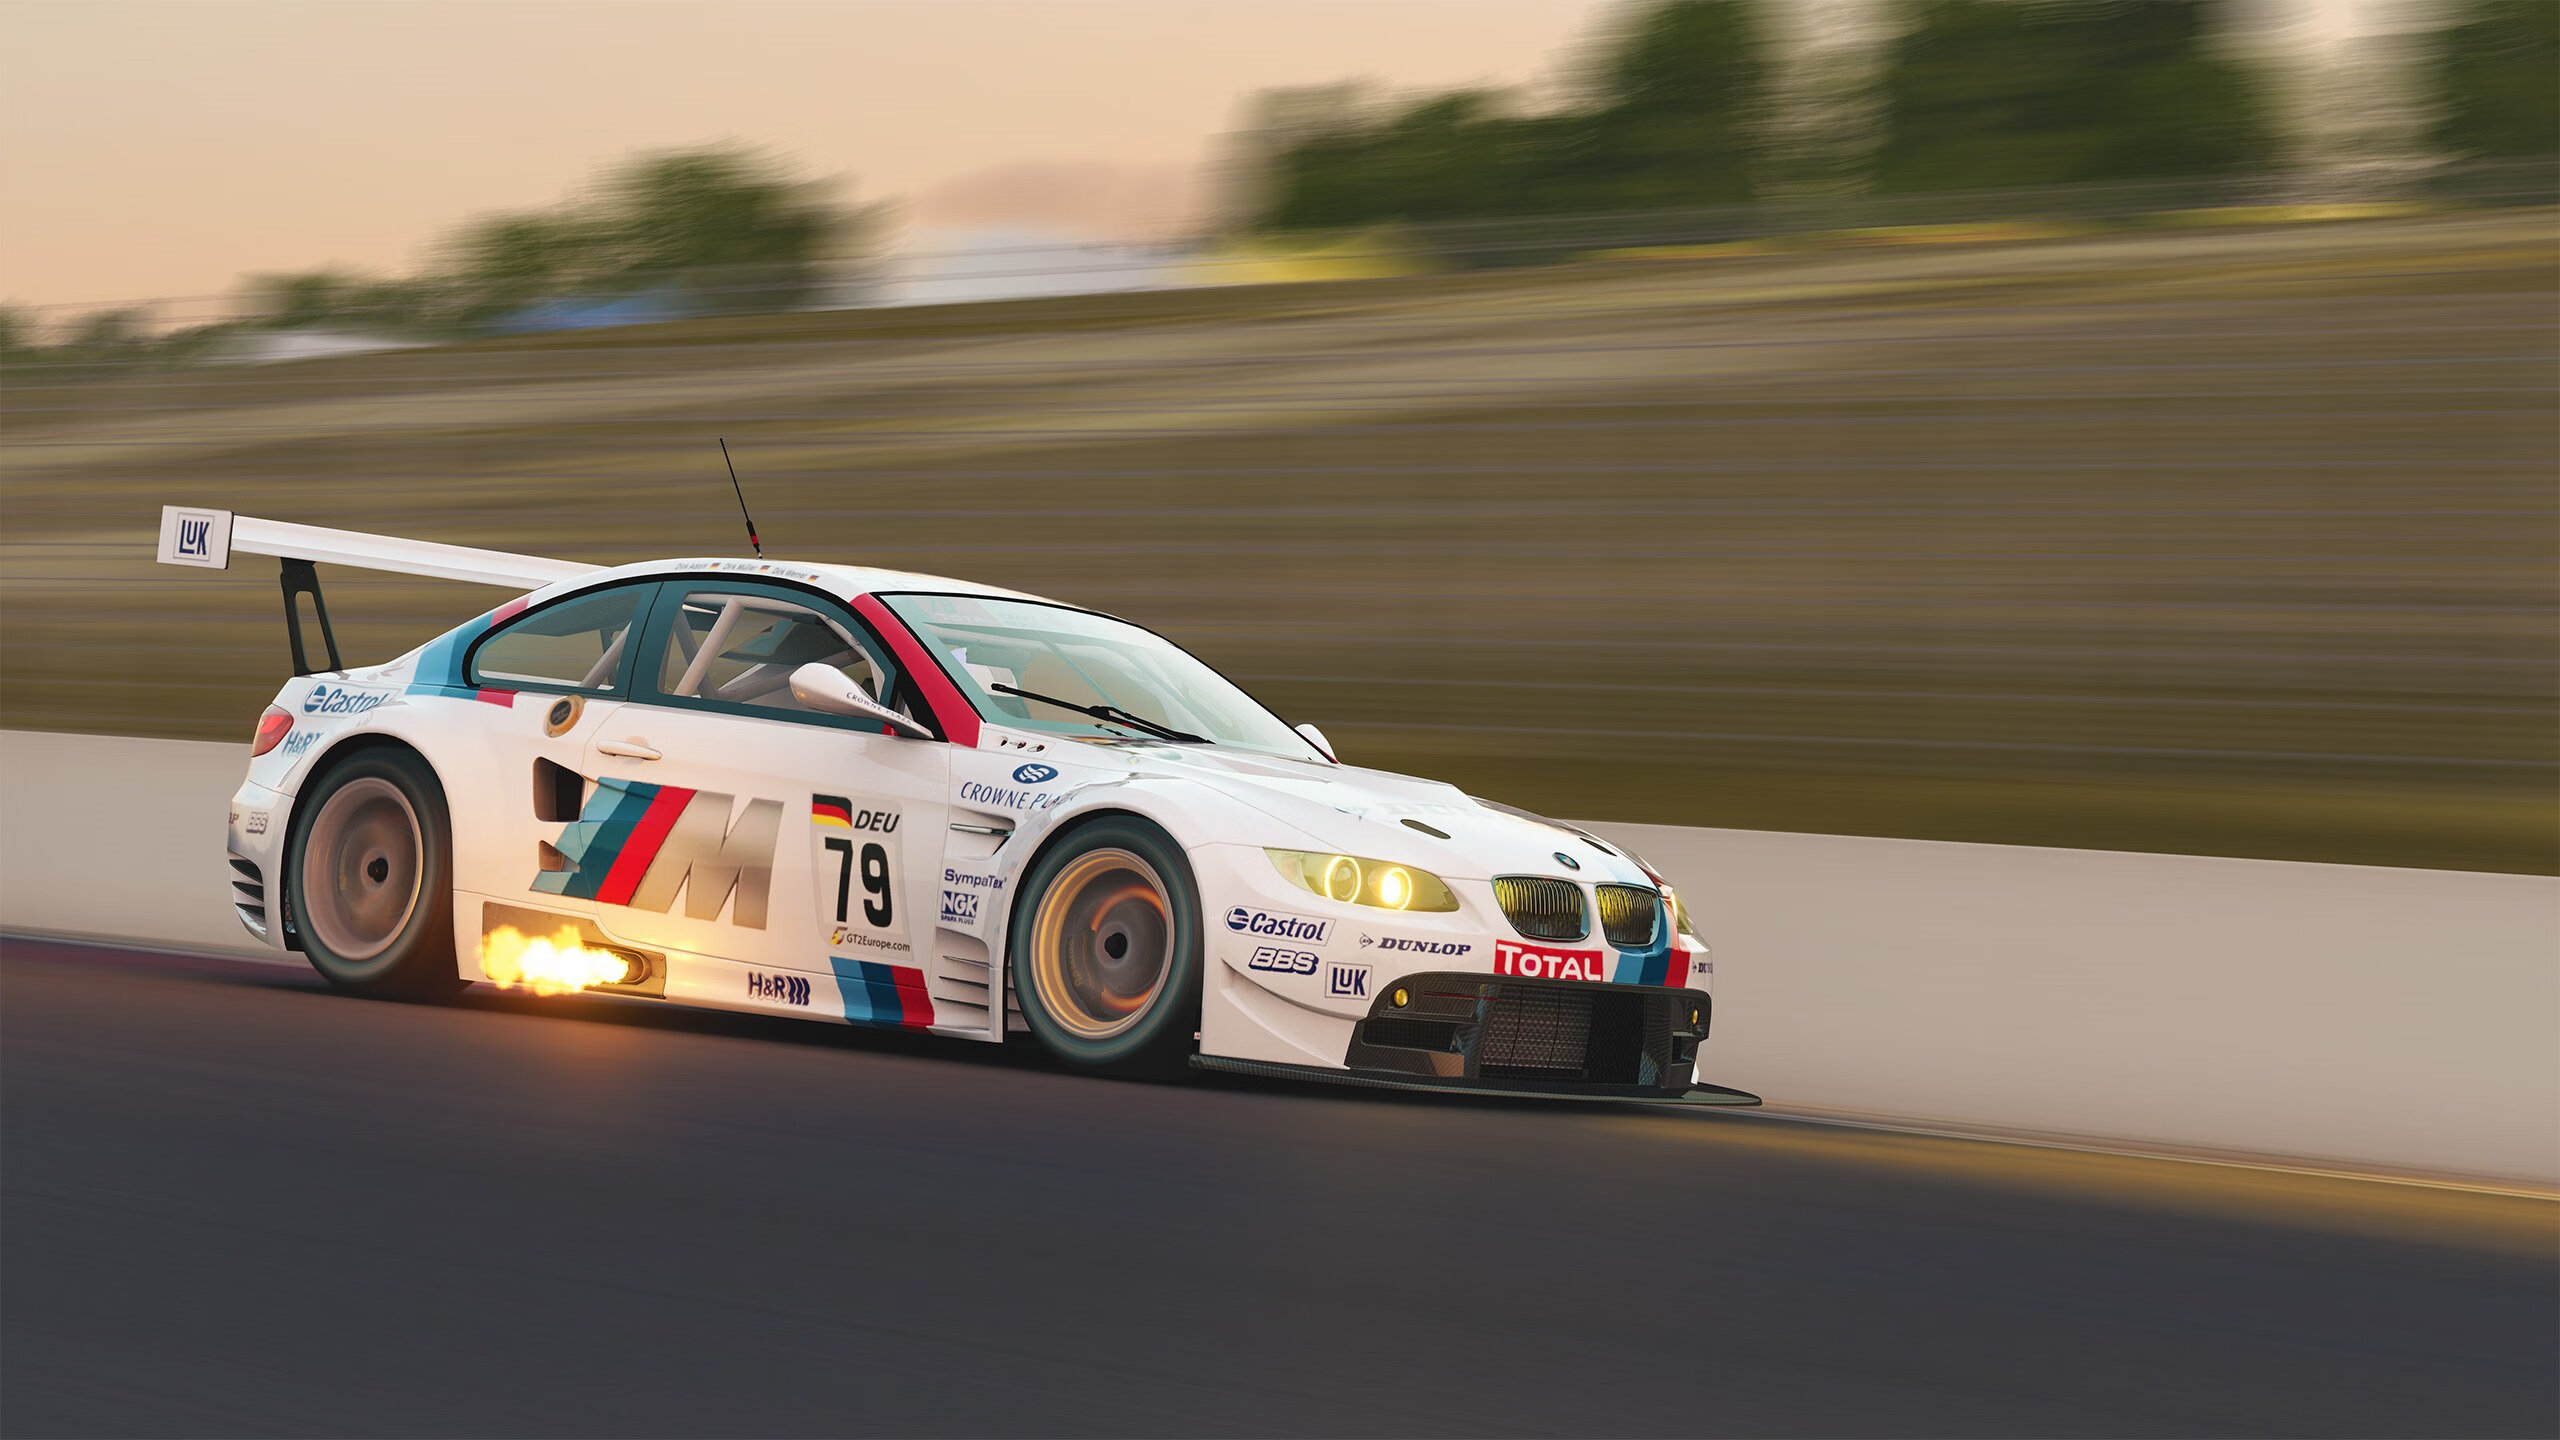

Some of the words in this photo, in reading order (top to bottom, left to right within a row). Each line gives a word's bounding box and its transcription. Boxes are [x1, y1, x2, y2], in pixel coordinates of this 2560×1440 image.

[179, 520, 209, 555] LUK
[846, 692, 882, 712] CROWNE
[960, 781, 1030, 809] CROWNE
[854, 810, 900, 833] DEU
[825, 837, 893, 928] 79
[945, 868, 1003, 889] SympaTex
[941, 891, 978, 918] NGK
[1250, 912, 1327, 942] Castrol
[846, 933, 911, 952] GT2Europe.com
[1378, 937, 1472, 956] DUNLOP
[1248, 946, 1320, 976] BBS
[1497, 943, 1602, 981] TOTAL
[748, 972, 786, 1000] H&R
[1331, 967, 1368, 996] LUK
